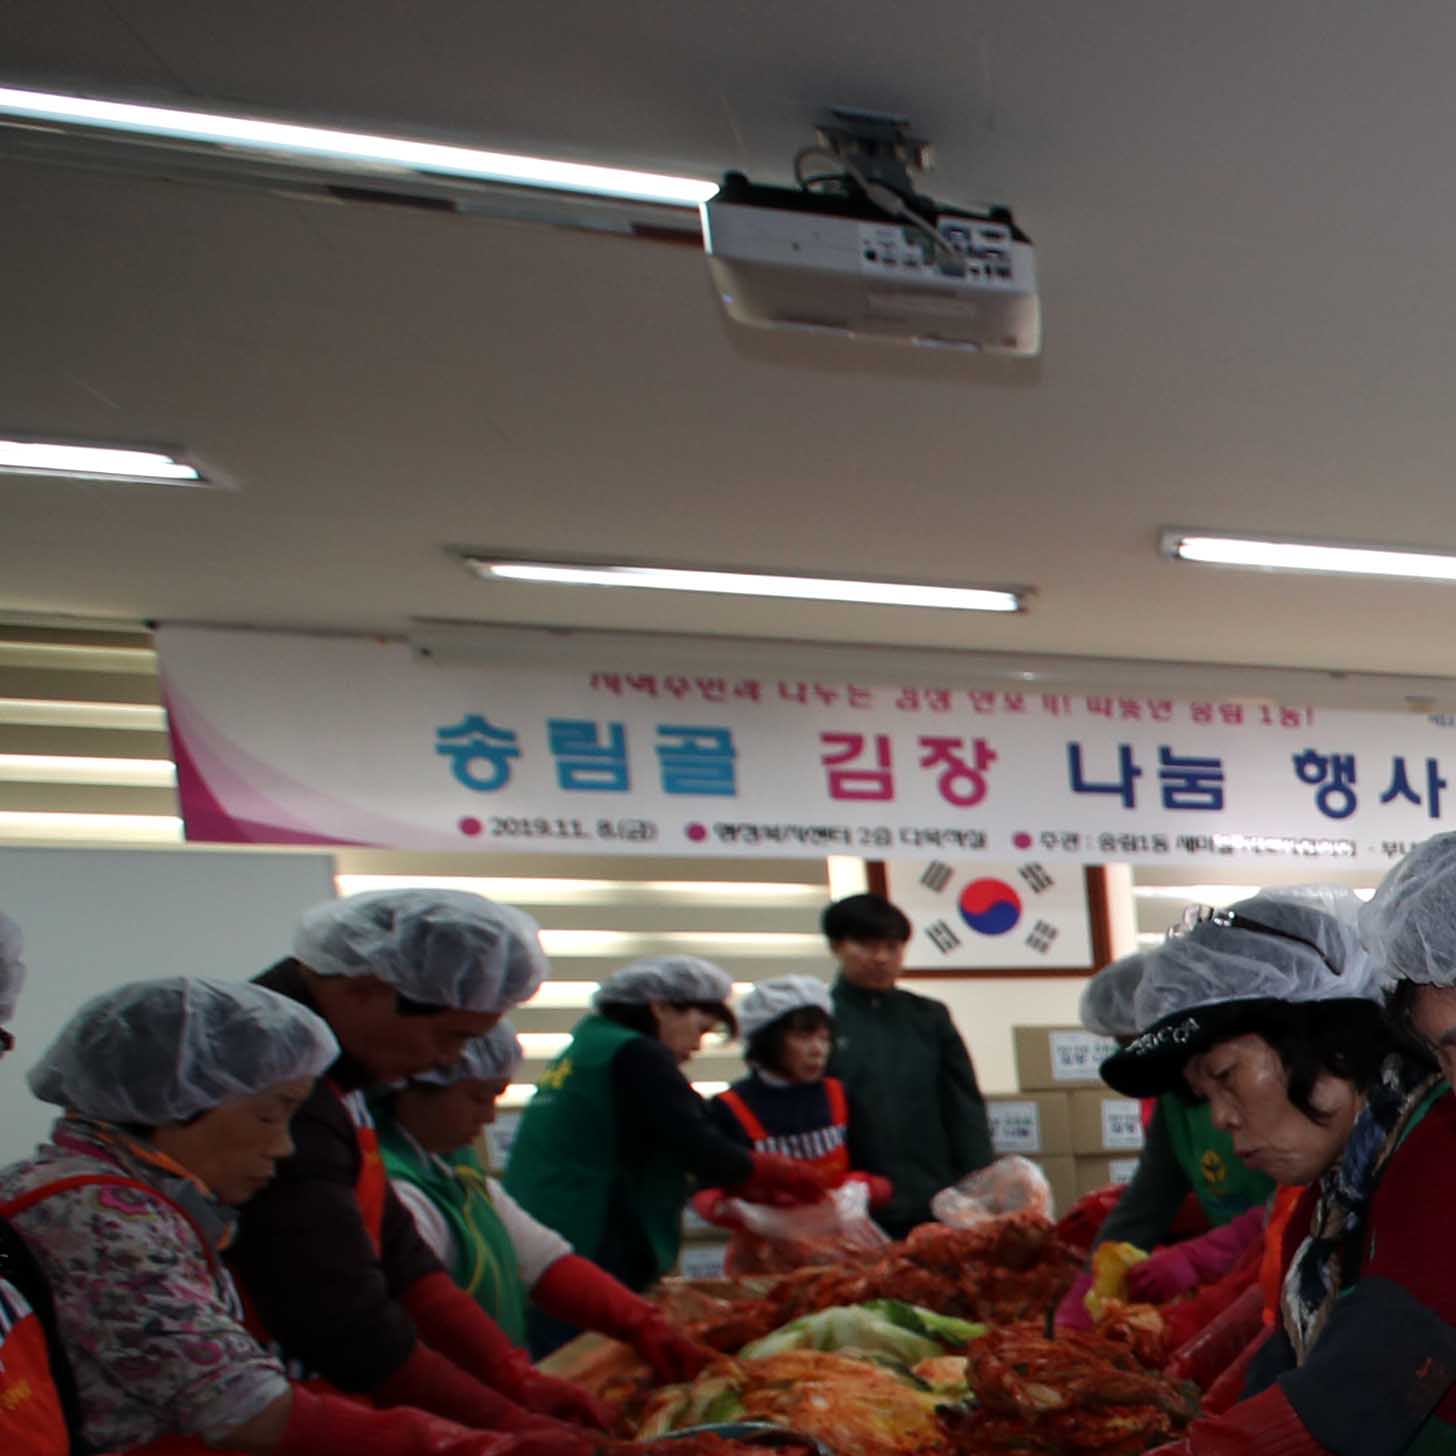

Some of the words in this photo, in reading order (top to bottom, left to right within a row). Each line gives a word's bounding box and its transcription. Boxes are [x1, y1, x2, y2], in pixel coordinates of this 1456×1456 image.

[434, 713, 740, 798] 송림골
[820, 731, 998, 807] 김장
[1067, 741, 1225, 811] 나눔
[1292, 748, 1448, 821] 행사
